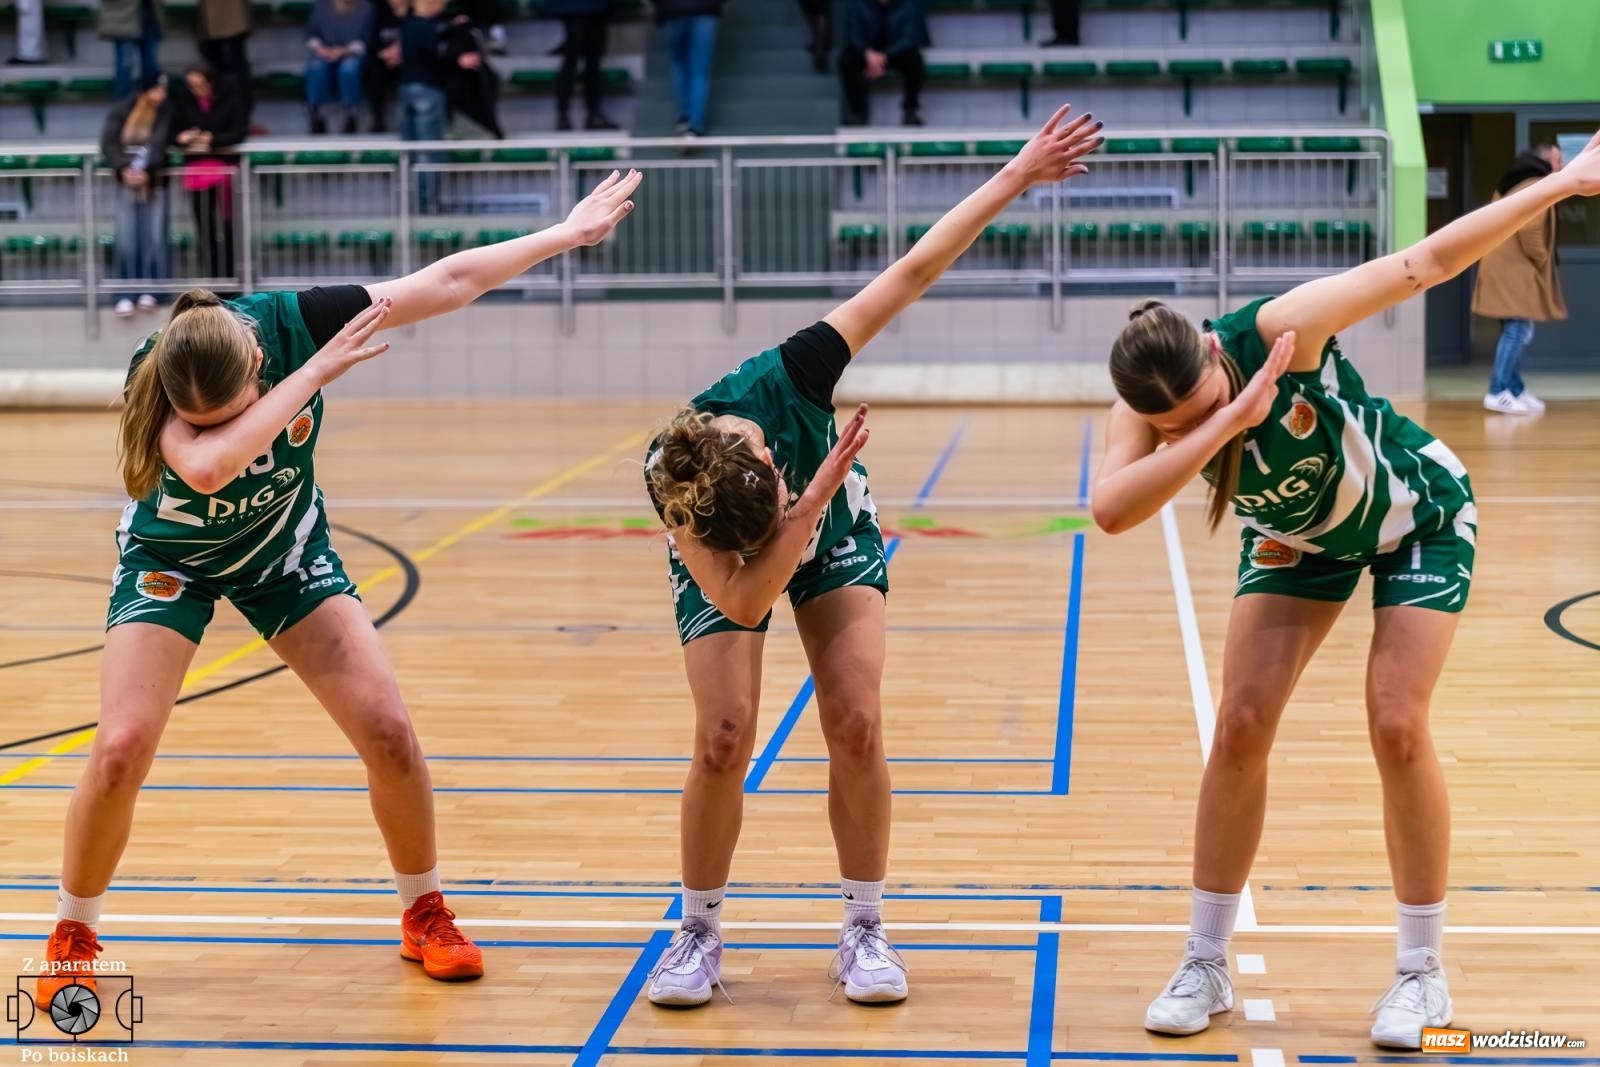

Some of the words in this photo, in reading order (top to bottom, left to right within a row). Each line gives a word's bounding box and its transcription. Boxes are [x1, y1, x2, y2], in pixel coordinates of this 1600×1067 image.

[1234, 475, 1310, 507] DIG
[208, 484, 275, 518] DIG
[822, 555, 868, 574] regio
[300, 576, 345, 594] regio
[1388, 574, 1446, 583] regio
